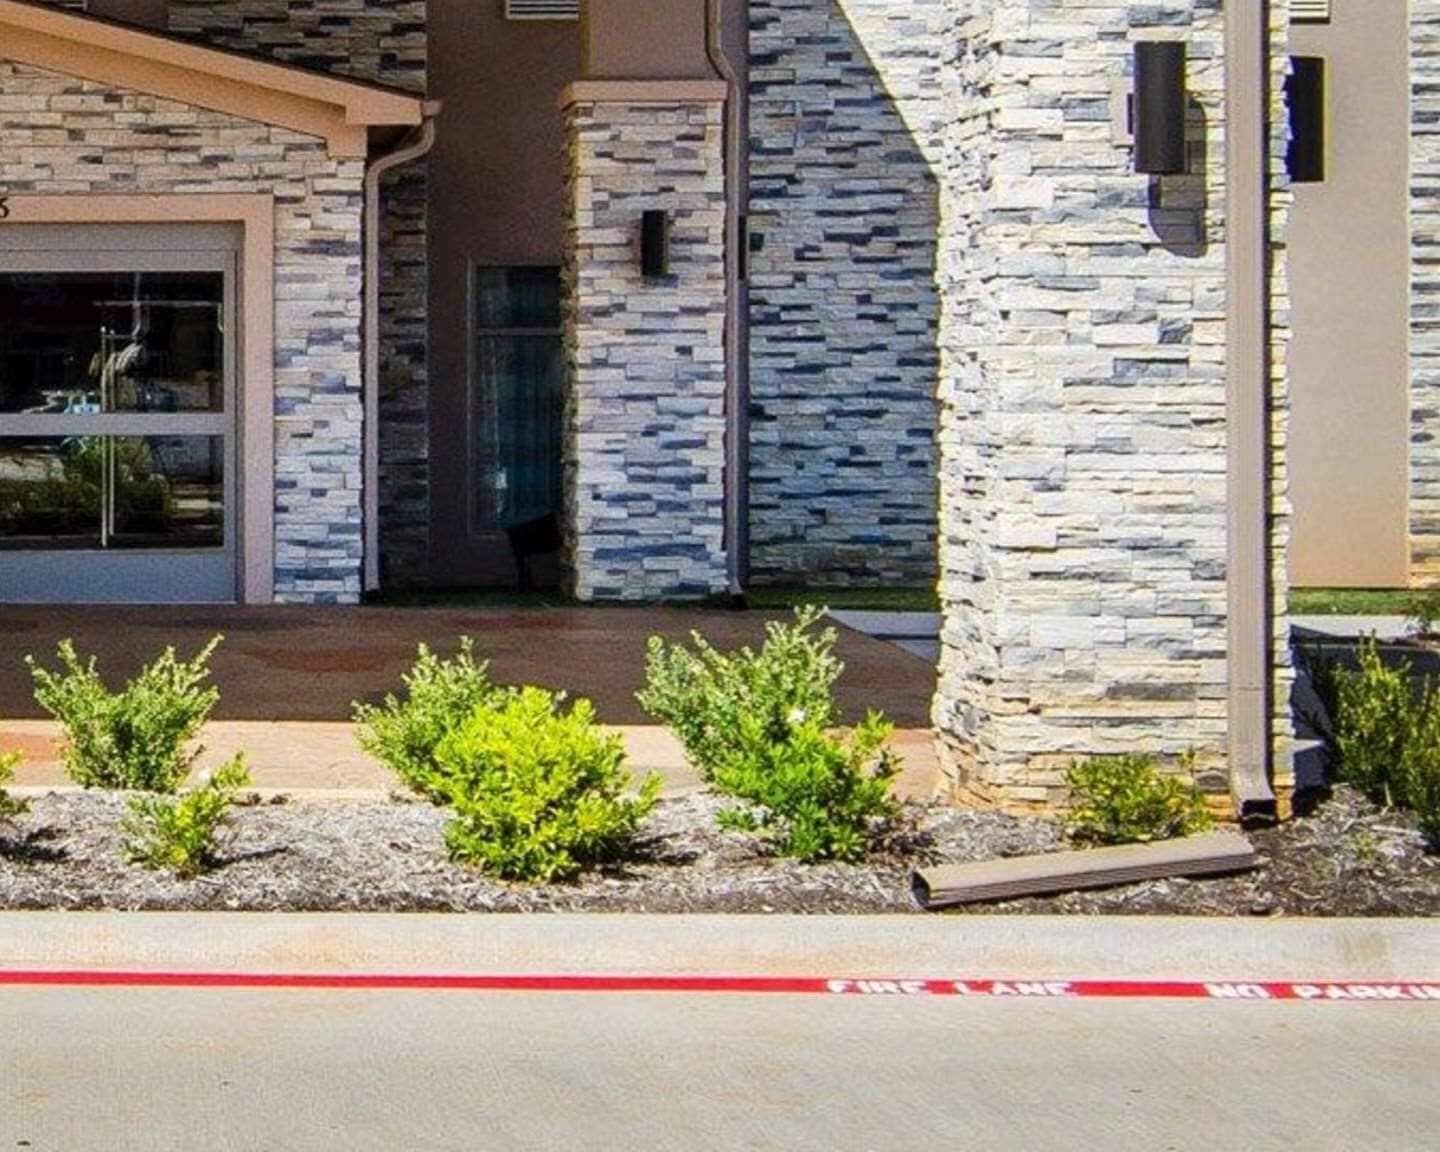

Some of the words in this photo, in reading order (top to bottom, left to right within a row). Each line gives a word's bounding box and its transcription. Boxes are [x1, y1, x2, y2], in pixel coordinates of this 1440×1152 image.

[826, 979, 928, 994] FIRE
[951, 980, 1079, 996] LANE
[1203, 982, 1272, 999] NO
